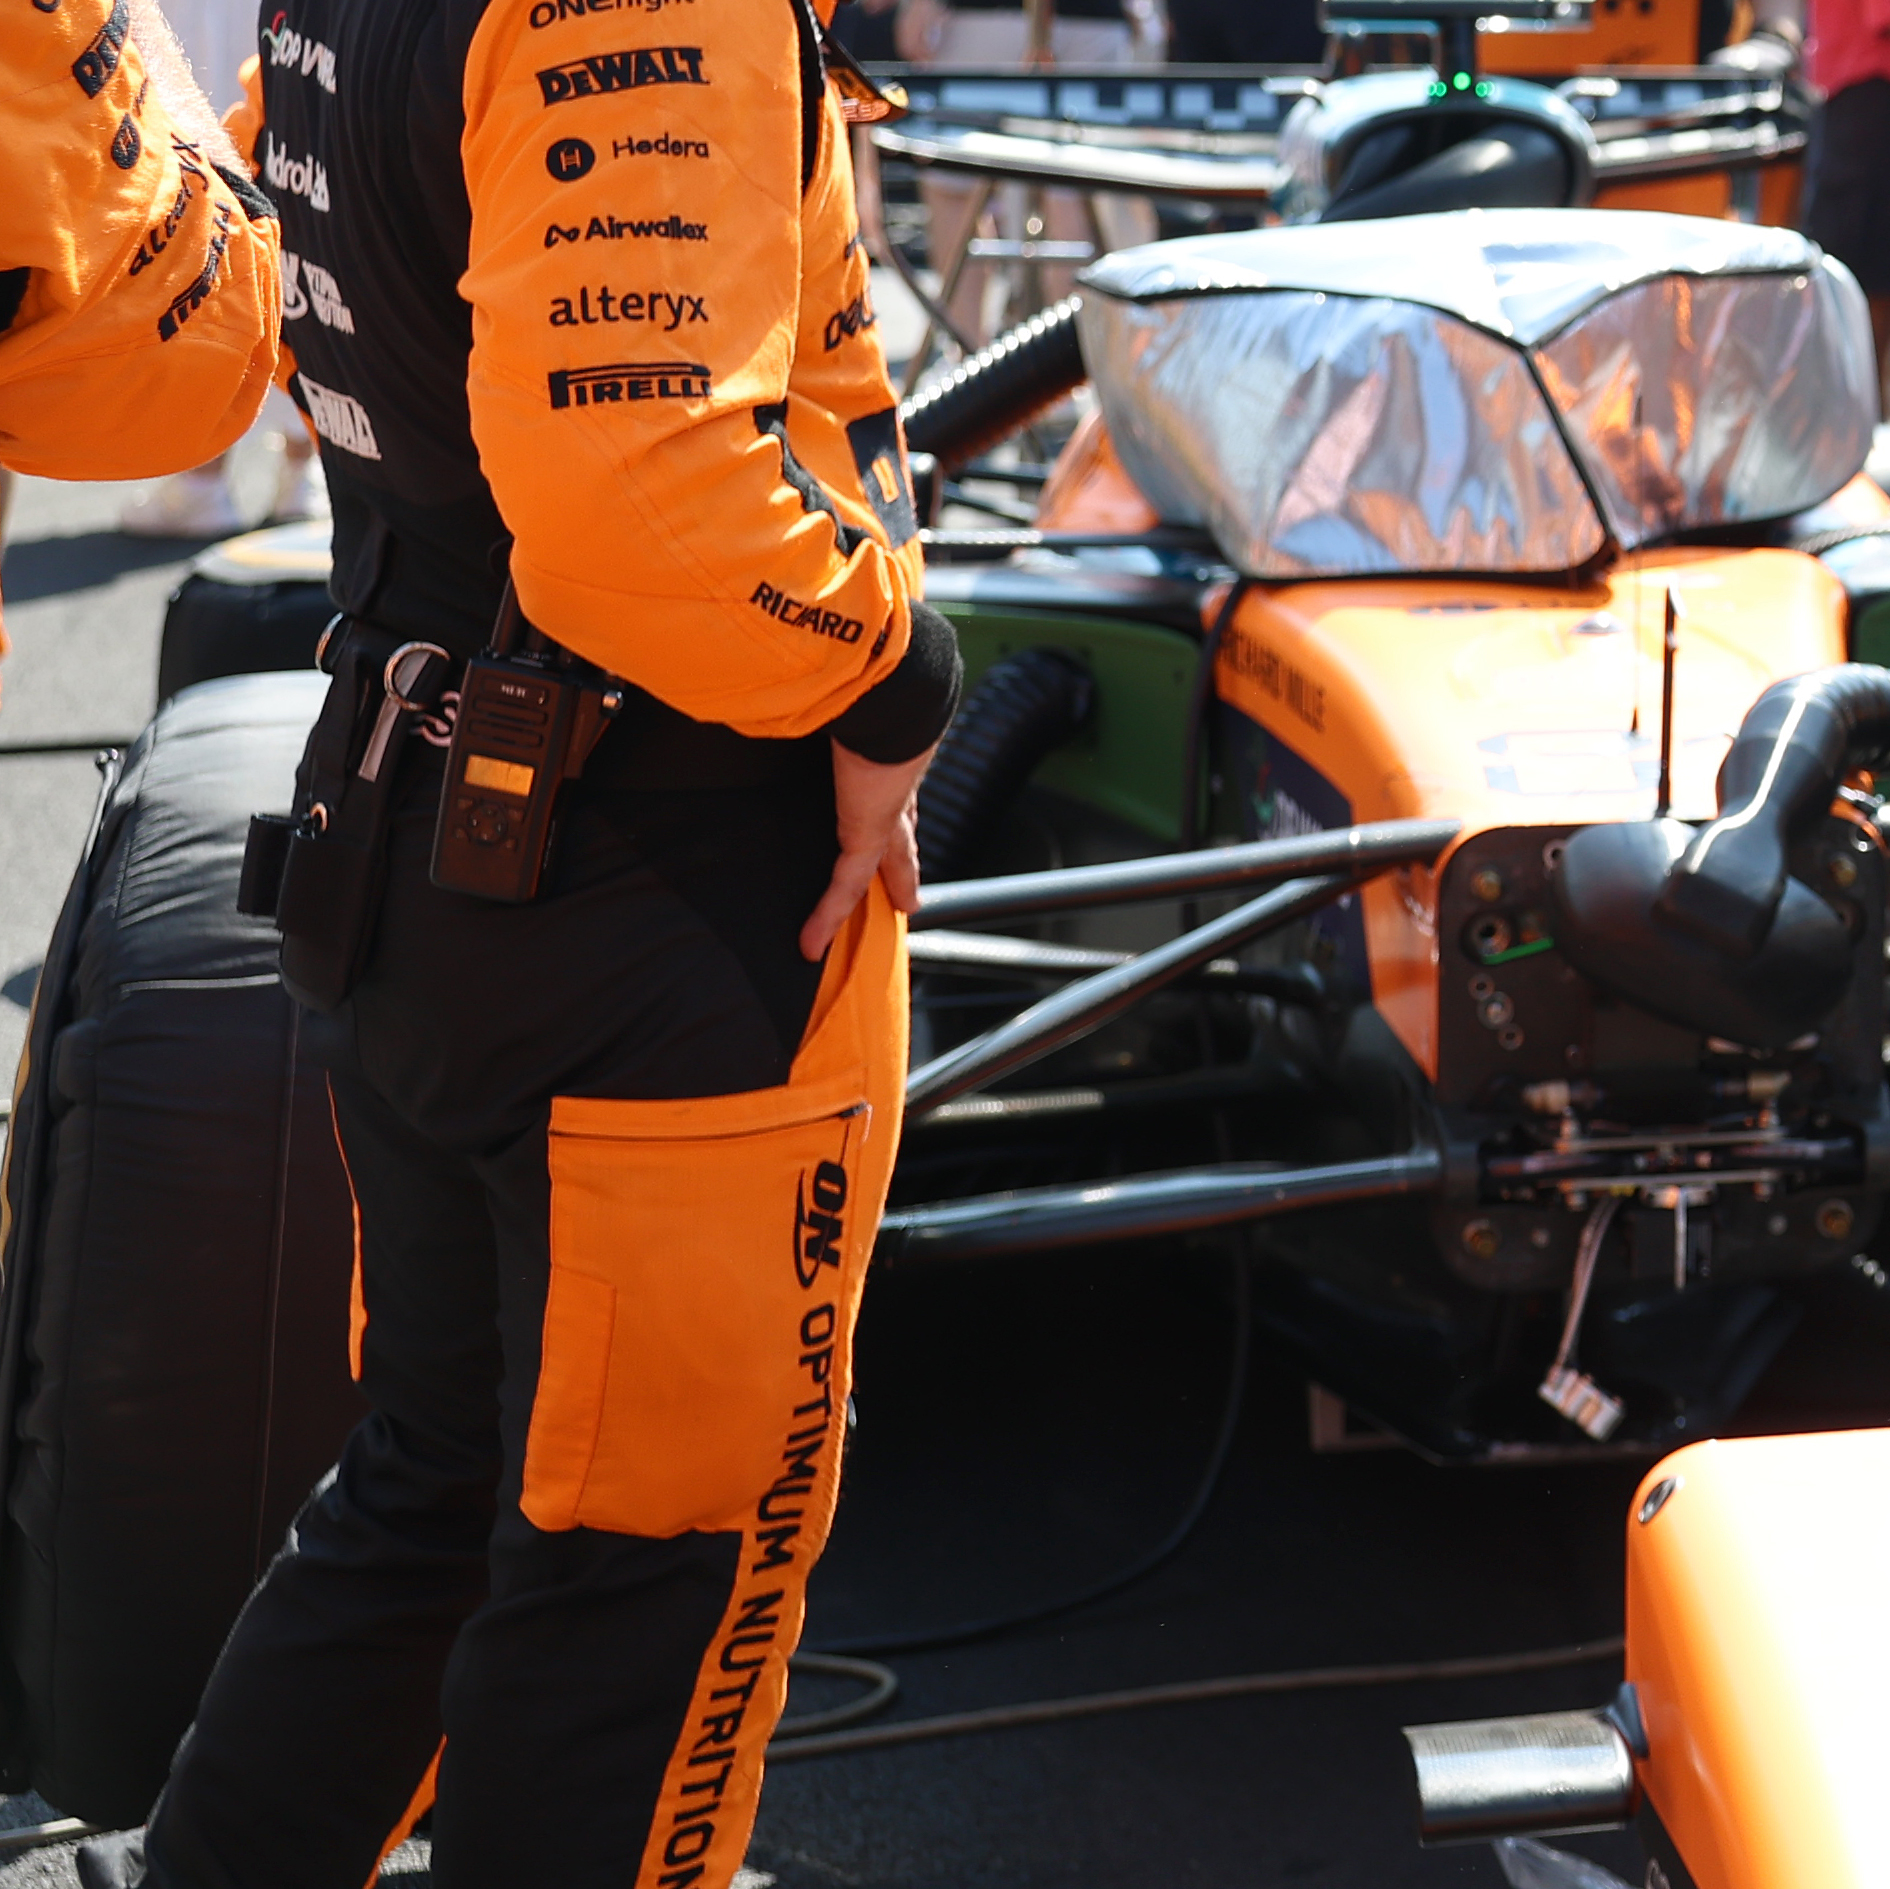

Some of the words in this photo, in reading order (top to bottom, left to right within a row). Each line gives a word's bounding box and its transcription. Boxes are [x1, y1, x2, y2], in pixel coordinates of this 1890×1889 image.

[536, 47, 712, 108] DEWALT
[612, 132, 709, 160] Hedera
[584, 215, 708, 242] Airwallex
[548, 285, 710, 331] alteryx
[753, 1301, 838, 1576] OPTIMUM
